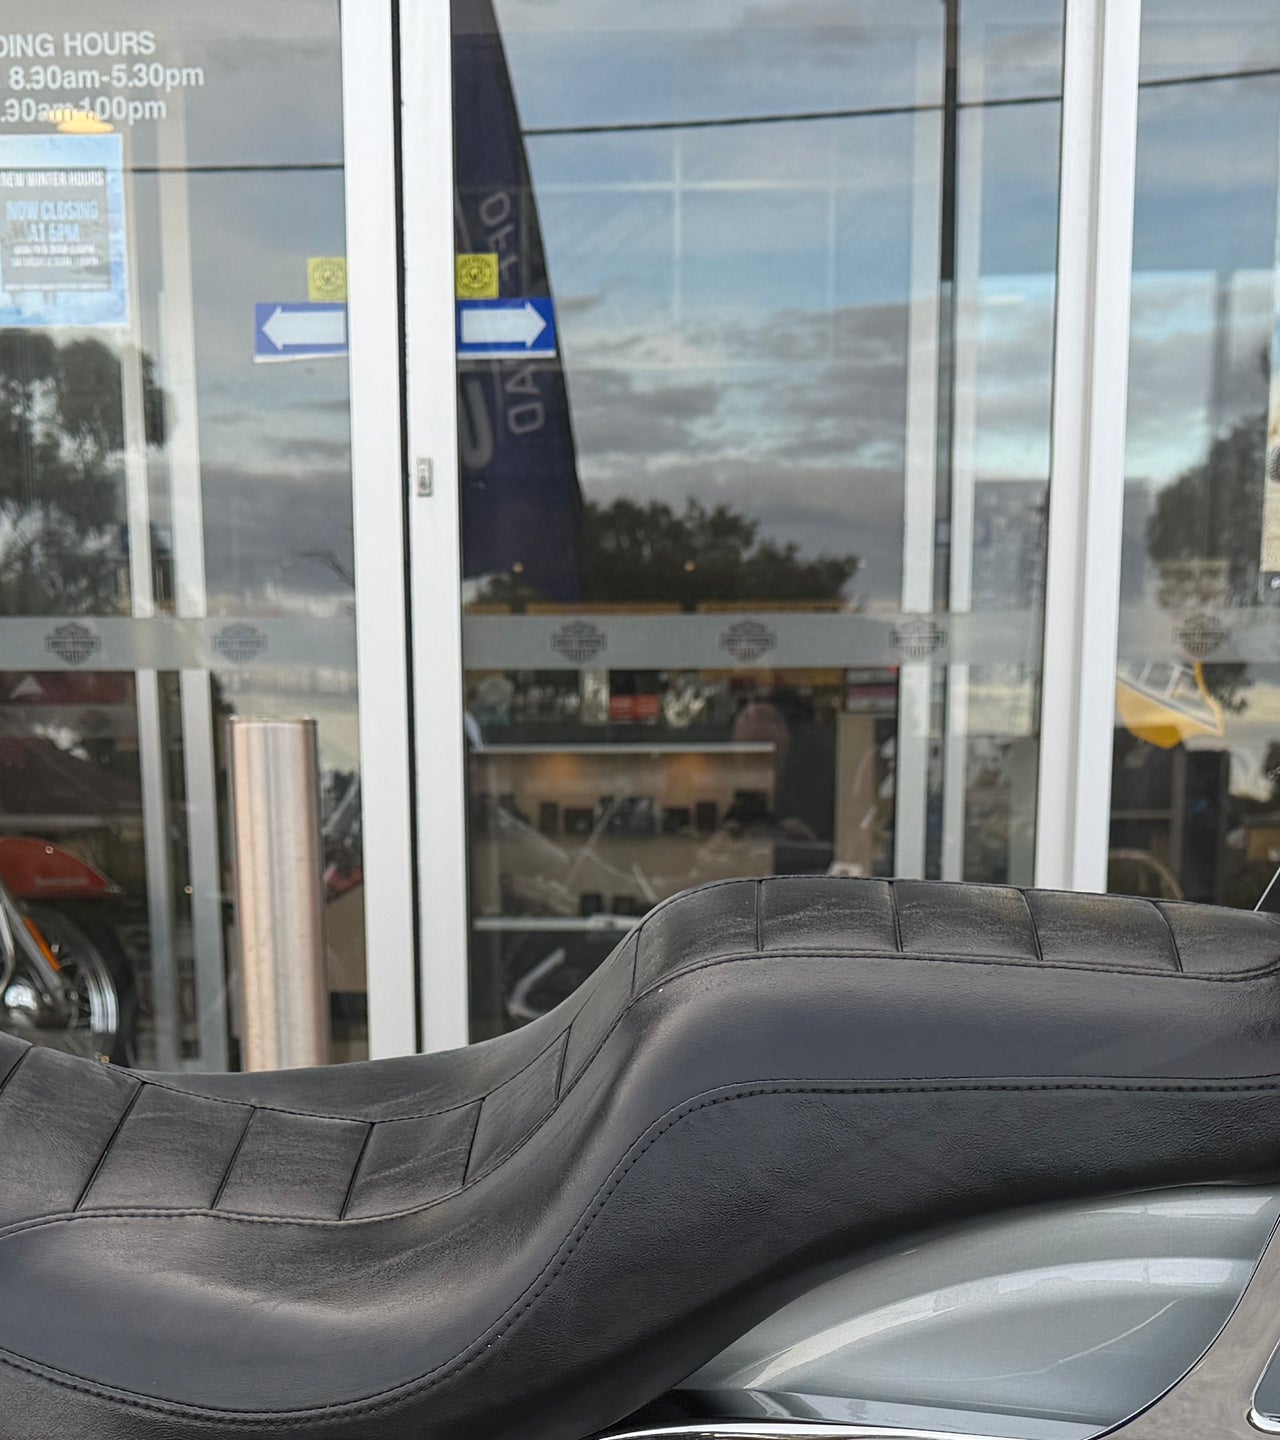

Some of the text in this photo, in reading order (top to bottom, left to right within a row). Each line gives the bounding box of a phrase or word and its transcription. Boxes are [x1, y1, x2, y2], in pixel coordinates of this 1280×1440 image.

[63, 31, 157, 56] HOURS
[10, 63, 205, 92] 8.30am-5.30pm
[6, 200, 99, 220] NOW CLOSING
